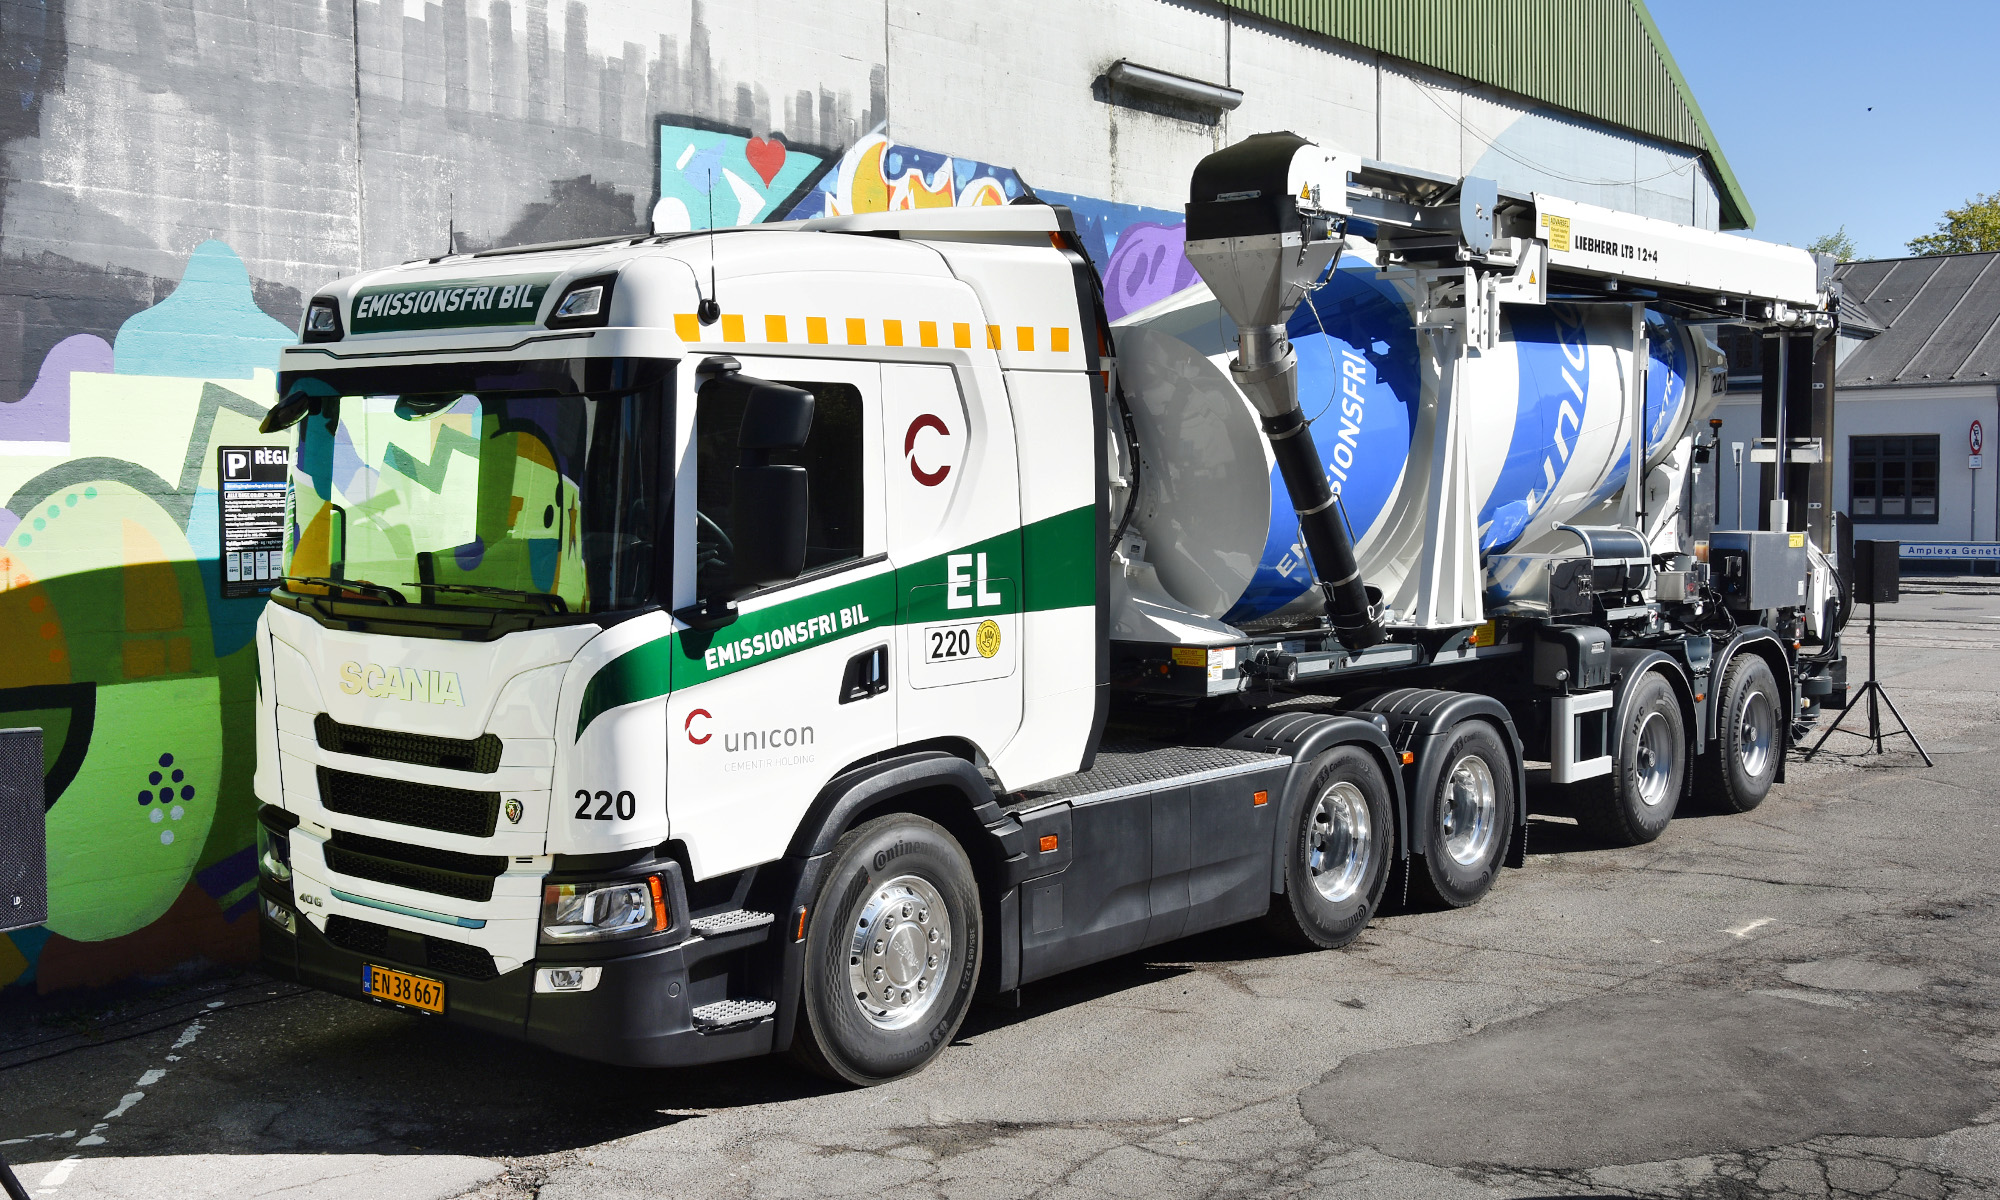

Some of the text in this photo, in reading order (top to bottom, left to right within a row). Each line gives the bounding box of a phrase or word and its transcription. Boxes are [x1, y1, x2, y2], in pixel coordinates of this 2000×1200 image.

[1575, 235, 1618, 257] LIEBHERR
[1621, 244, 1634, 259] LTB
[1637, 247, 1658, 263] 12+4
[356, 284, 534, 319] EMISSIONSFRI BIL
[1712, 373, 1727, 394] 221
[227, 449, 288, 477] P REGL
[1908, 546, 1957, 555] Amplexa
[947, 552, 1001, 610] EL
[704, 604, 869, 671] EMISSIONSFRI BIL
[931, 629, 970, 659] 220
[340, 661, 465, 707] SCANIA
[724, 726, 814, 752] unicon
[724, 755, 815, 773] CEMENTIR HOLDING
[575, 789, 636, 821] 220
[967, 928, 976, 960] 385/65
[372, 971, 390, 995] EN
[393, 976, 411, 1000] 38
[414, 981, 441, 1007] 667
